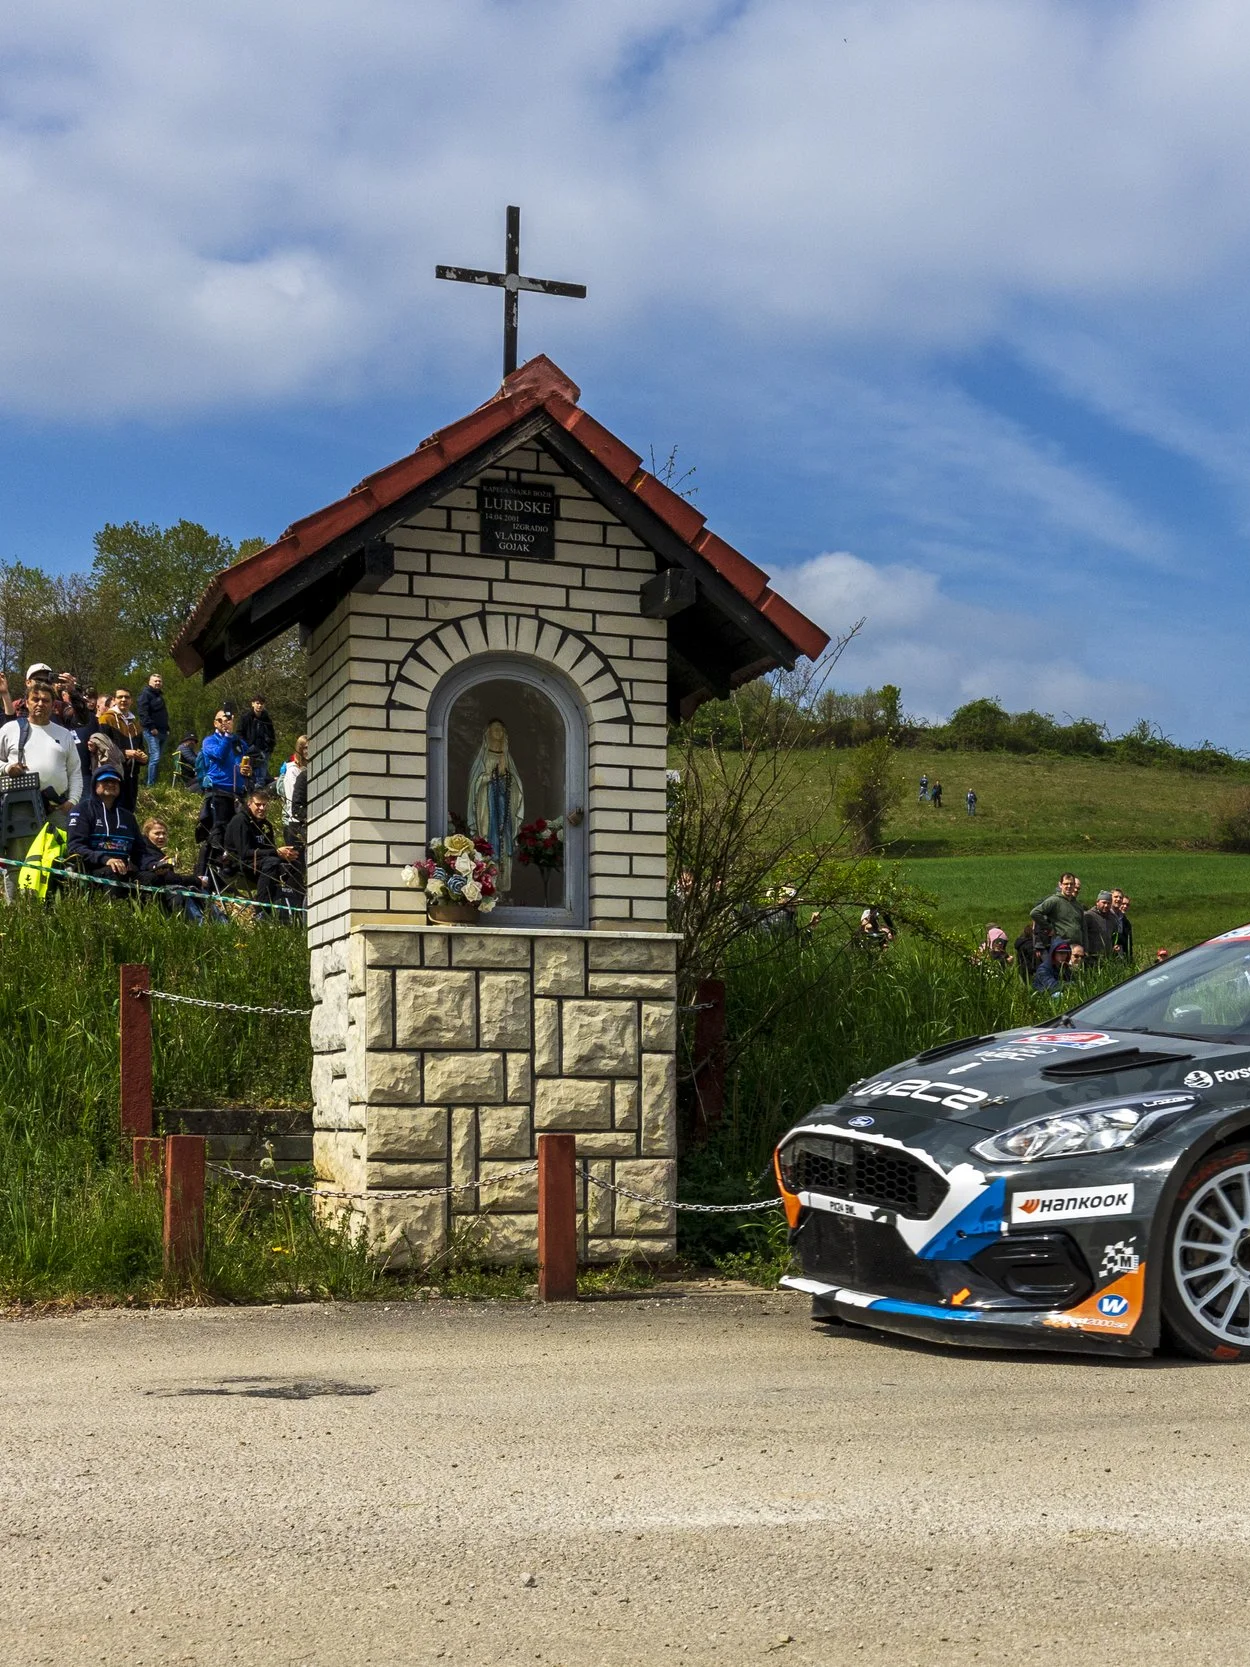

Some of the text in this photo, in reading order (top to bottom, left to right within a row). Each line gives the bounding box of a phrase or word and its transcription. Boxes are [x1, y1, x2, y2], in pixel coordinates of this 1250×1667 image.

[484, 497, 551, 514] LURDSKE
[512, 523, 549, 533] IZGRADIO
[495, 531, 535, 543] VLADKO
[498, 542, 530, 552] GOJAK
[853, 1079, 989, 1111] WRC2
